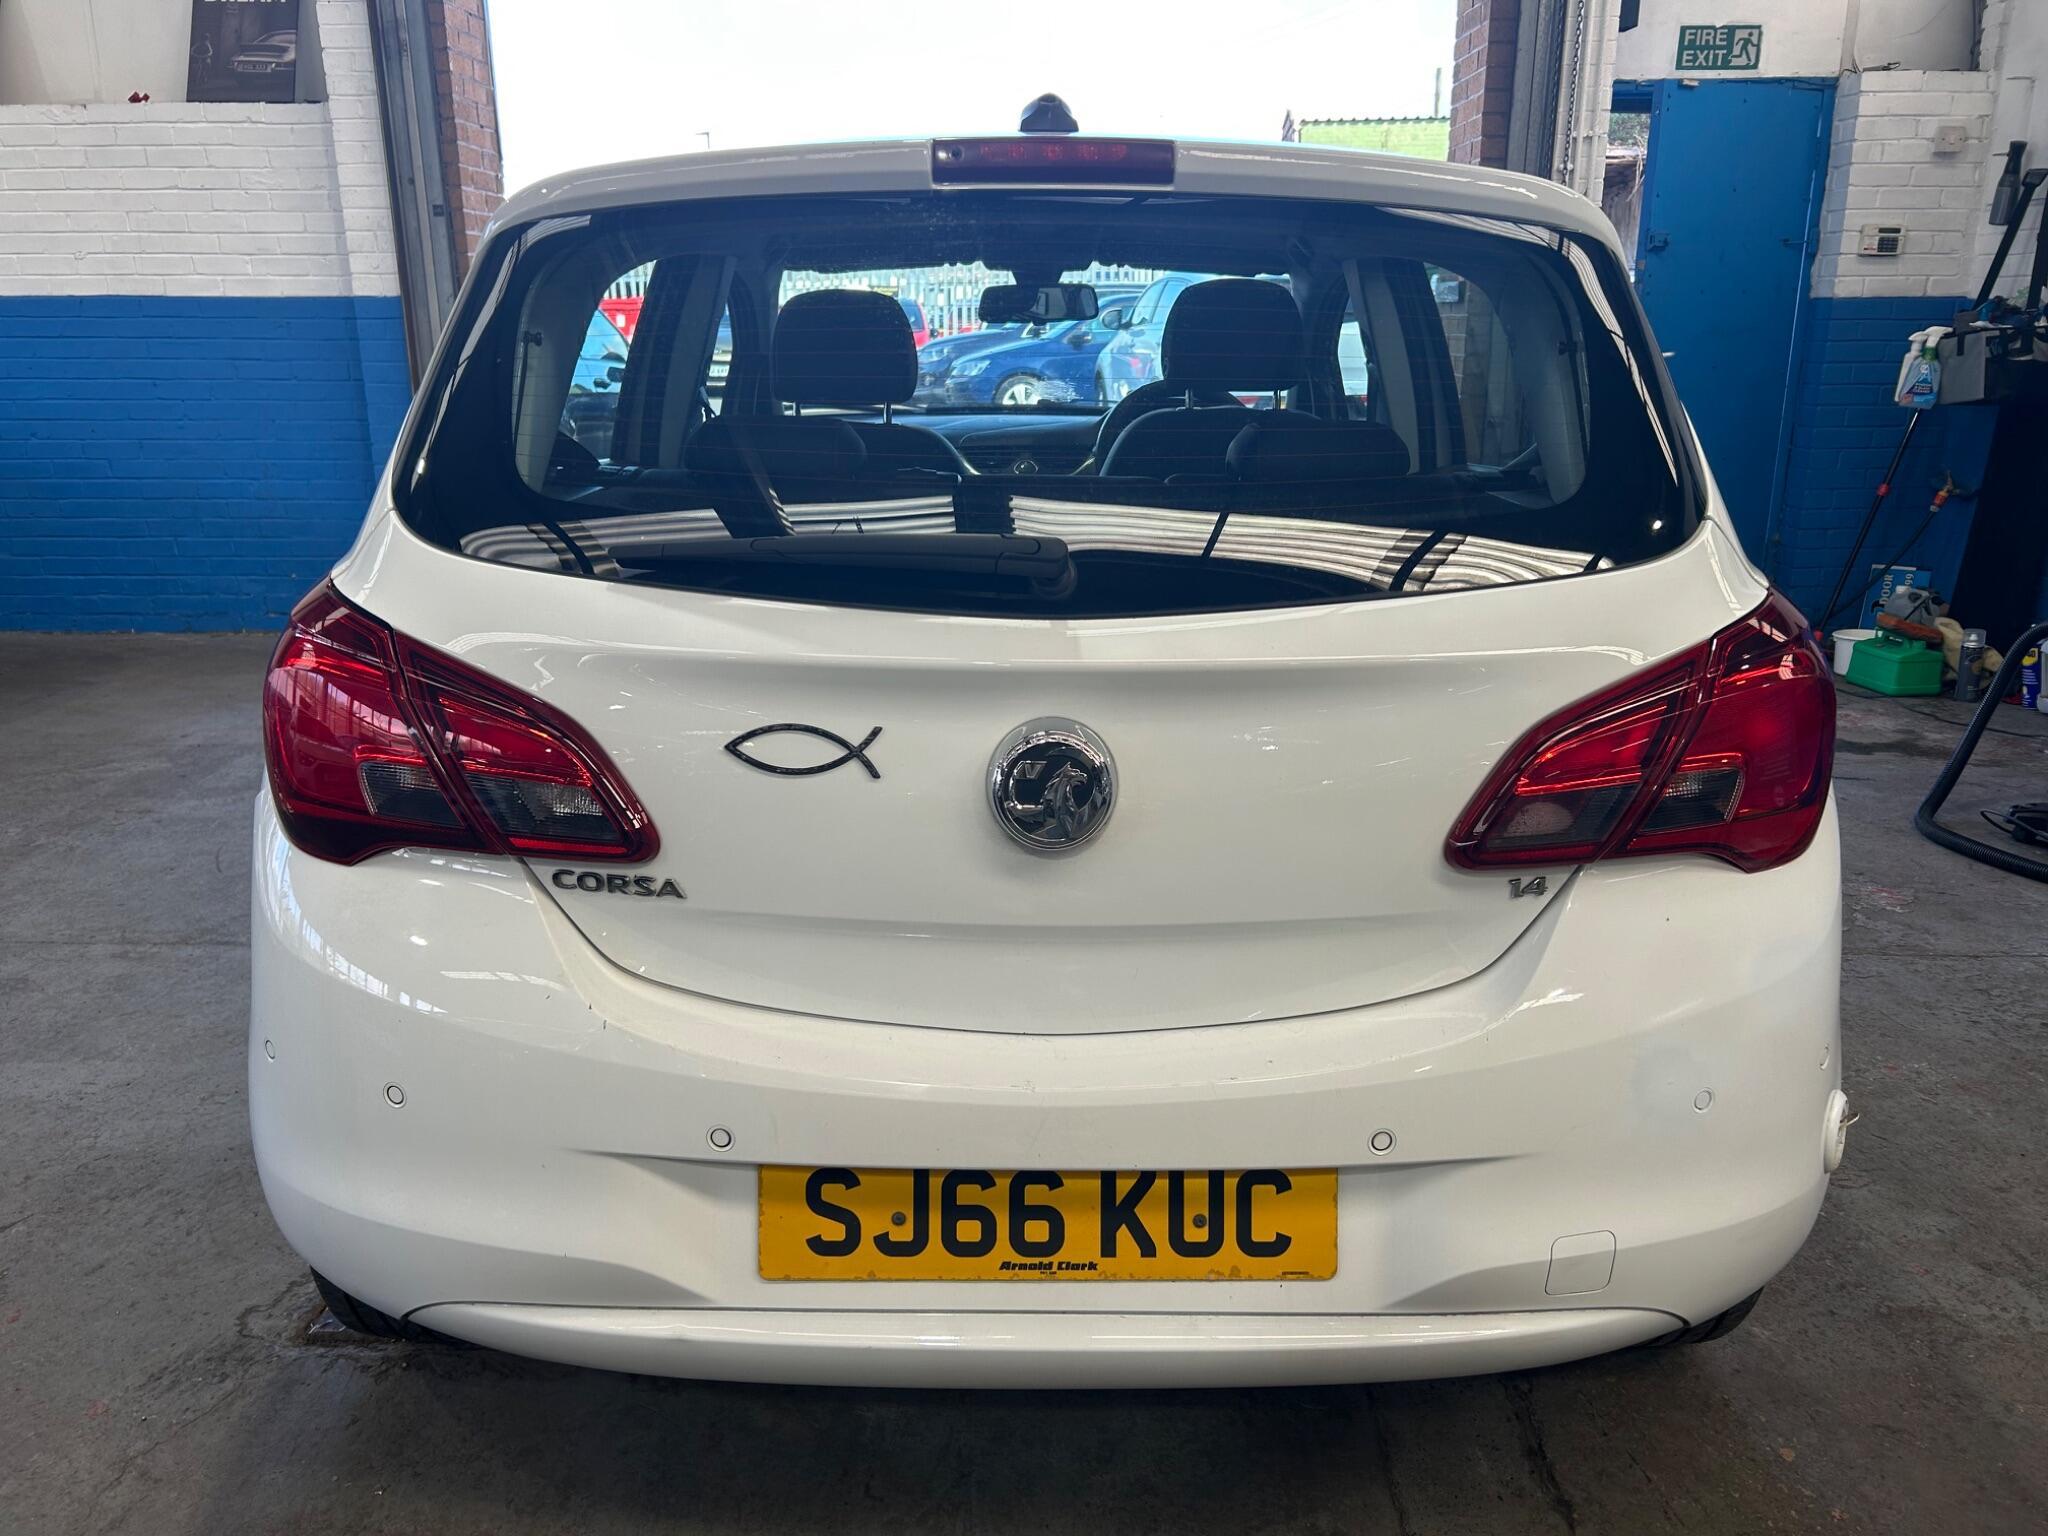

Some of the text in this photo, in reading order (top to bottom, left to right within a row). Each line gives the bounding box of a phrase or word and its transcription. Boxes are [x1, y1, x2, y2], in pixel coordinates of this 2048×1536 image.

[1684, 29, 1728, 46] FIRE
[1681, 50, 1727, 66] EXIT
[1879, 574, 1894, 605] DOOR
[552, 869, 687, 900] CORSA
[805, 1166, 1293, 1258] SJ66 KUC
[999, 1260, 1098, 1271] Arnold Clark
